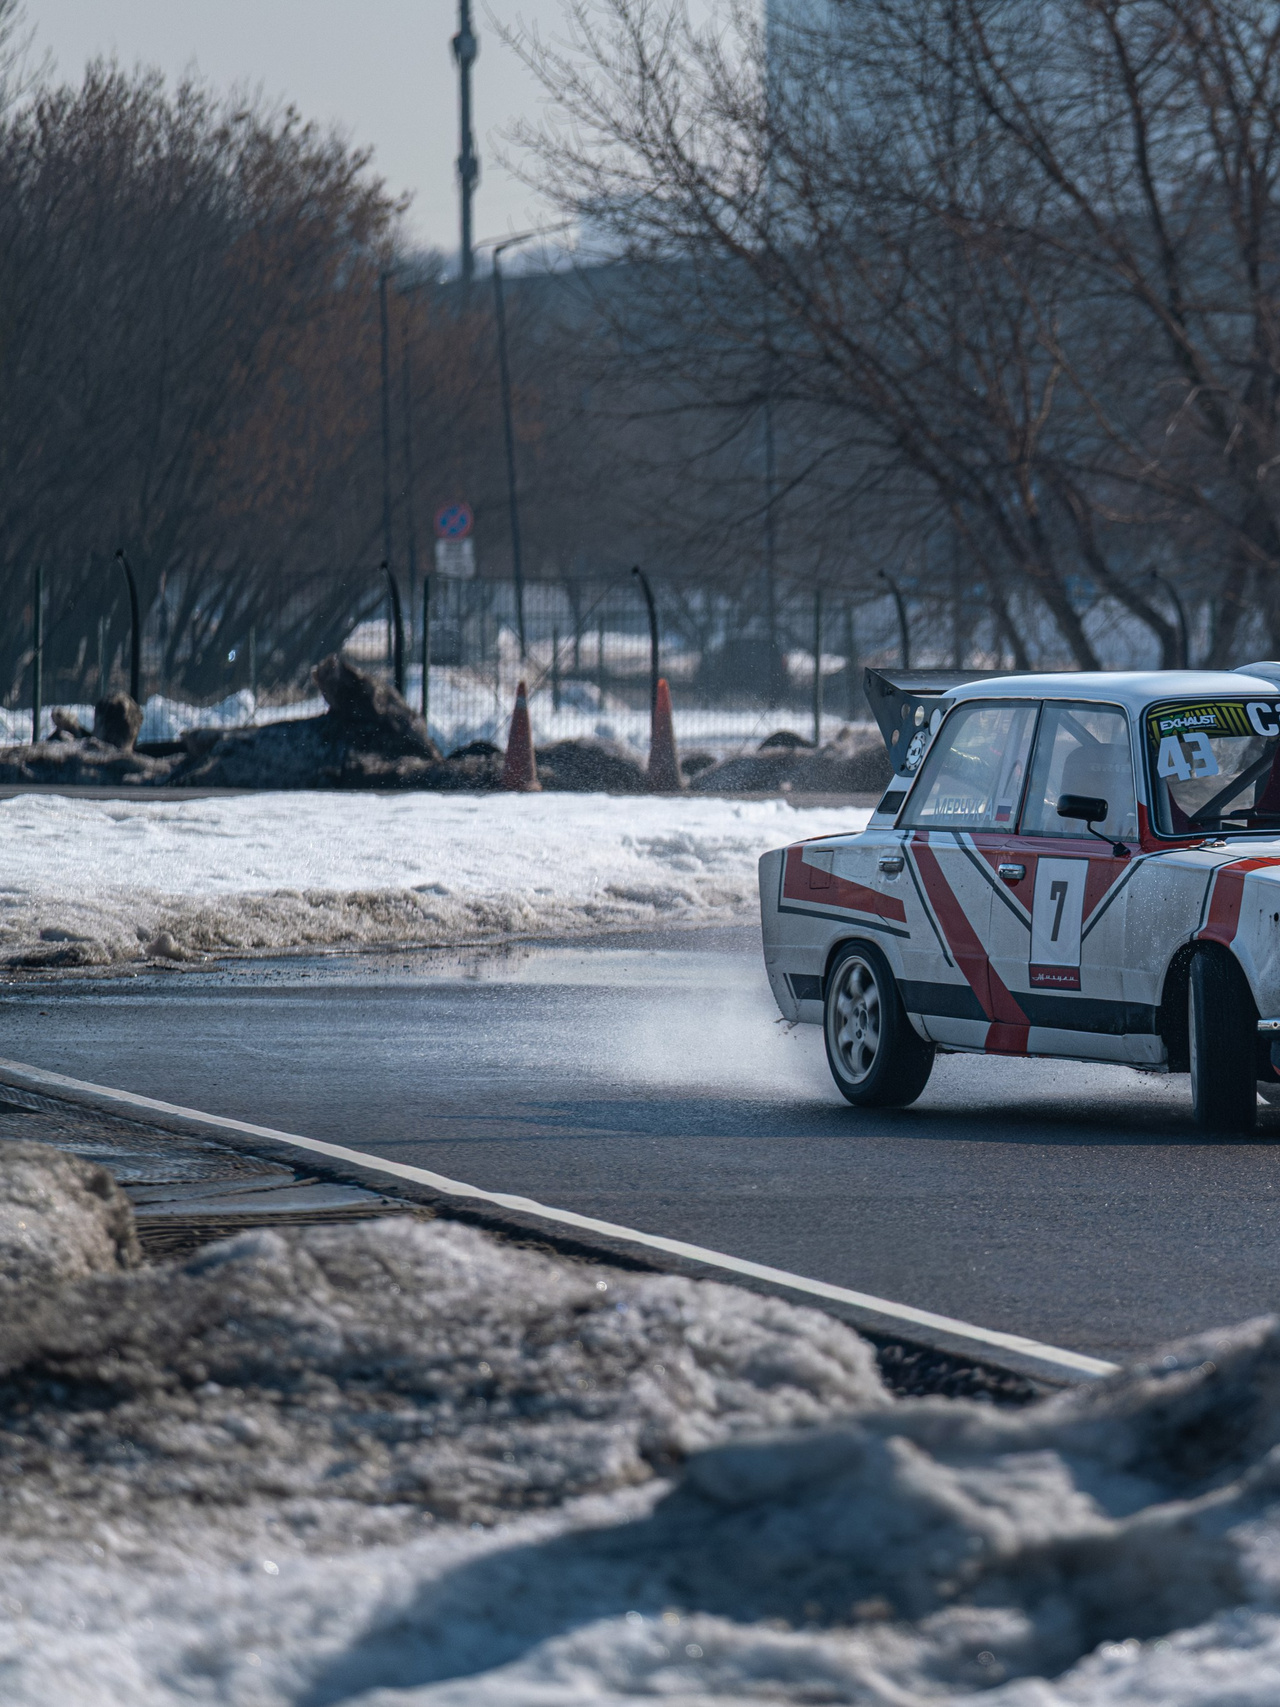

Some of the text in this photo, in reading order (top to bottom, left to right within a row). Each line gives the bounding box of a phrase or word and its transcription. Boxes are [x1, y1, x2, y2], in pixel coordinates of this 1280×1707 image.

[1160, 714, 1216, 731] EXHAUST
[1157, 732, 1219, 781] 43
[1050, 881, 1068, 941] 7
